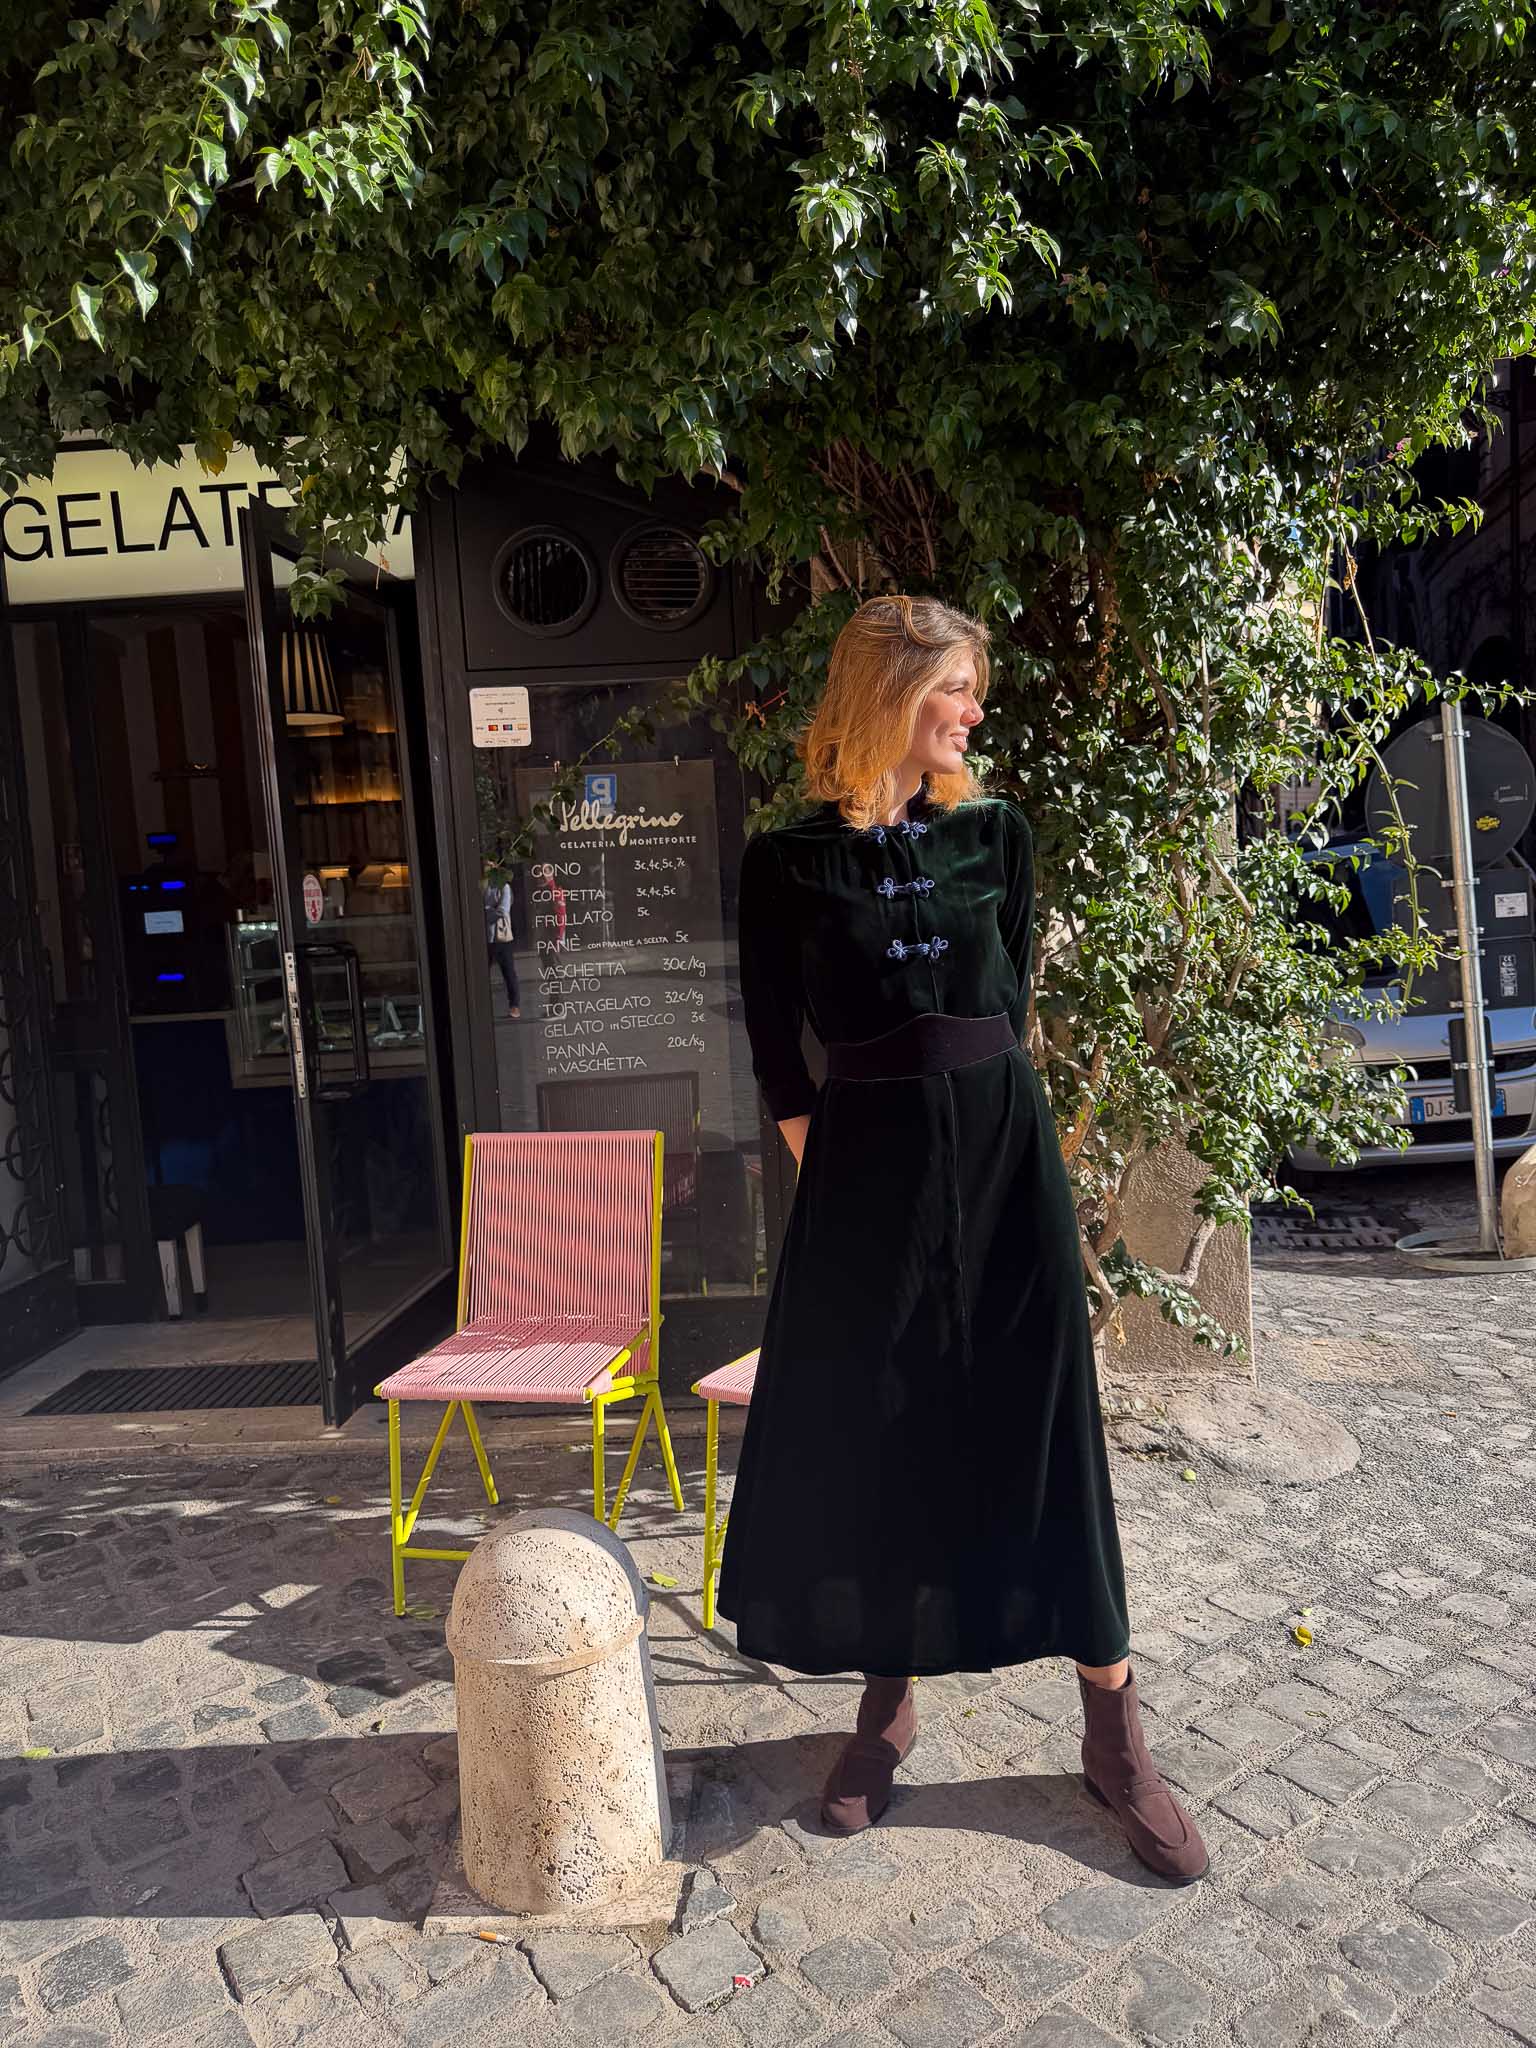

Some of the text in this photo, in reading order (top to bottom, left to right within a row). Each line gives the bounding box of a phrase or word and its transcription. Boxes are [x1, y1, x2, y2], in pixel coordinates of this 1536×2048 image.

[550, 792, 684, 846] Pellegrino
[560, 835, 697, 849] GELATERIA MONTEFORTE
[531, 862, 581, 878] CONO
[532, 889, 605, 902] COPPETTA
[535, 910, 613, 928] FRULLATO
[537, 934, 581, 954] PANÈ
[538, 962, 627, 981] VASCHETTA
[539, 978, 601, 995] GELATO
[544, 1020, 604, 1038] GELATO
[620, 1012, 676, 1030] STECCO
[546, 1041, 610, 1061] PANNA
[559, 1055, 648, 1074] VASCHETTA
